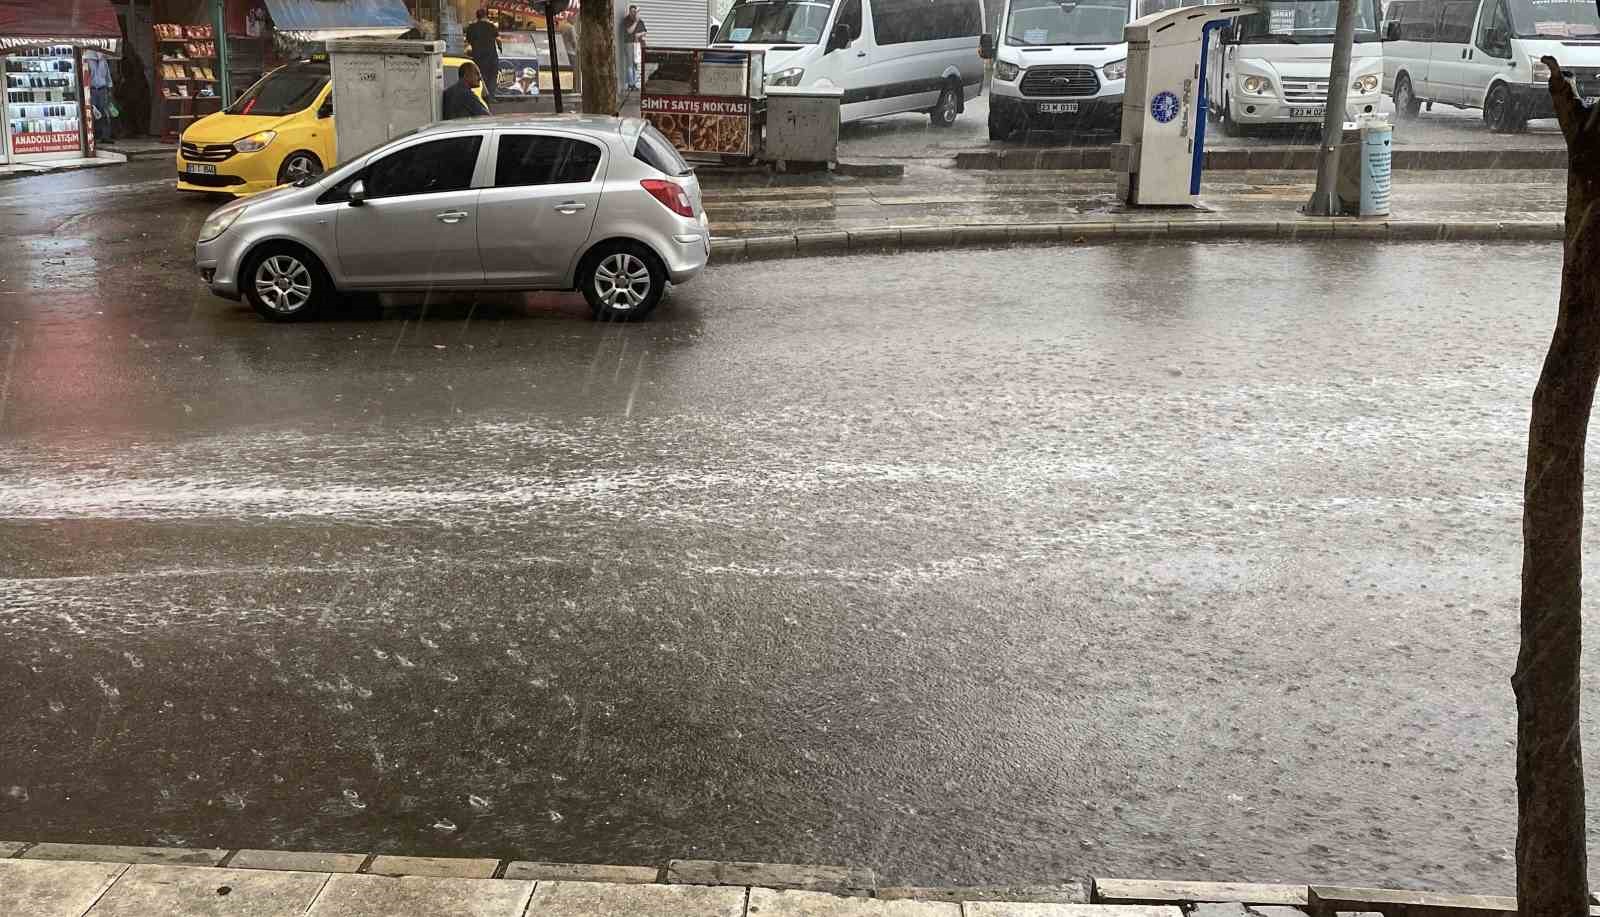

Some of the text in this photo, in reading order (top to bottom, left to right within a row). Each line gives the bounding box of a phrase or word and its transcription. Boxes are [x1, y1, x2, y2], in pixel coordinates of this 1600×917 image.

[641, 98, 747, 113] SİMİT SATIŞ NOKTASI
[15, 134, 80, 145] ANADOLU İLETİŞİM
